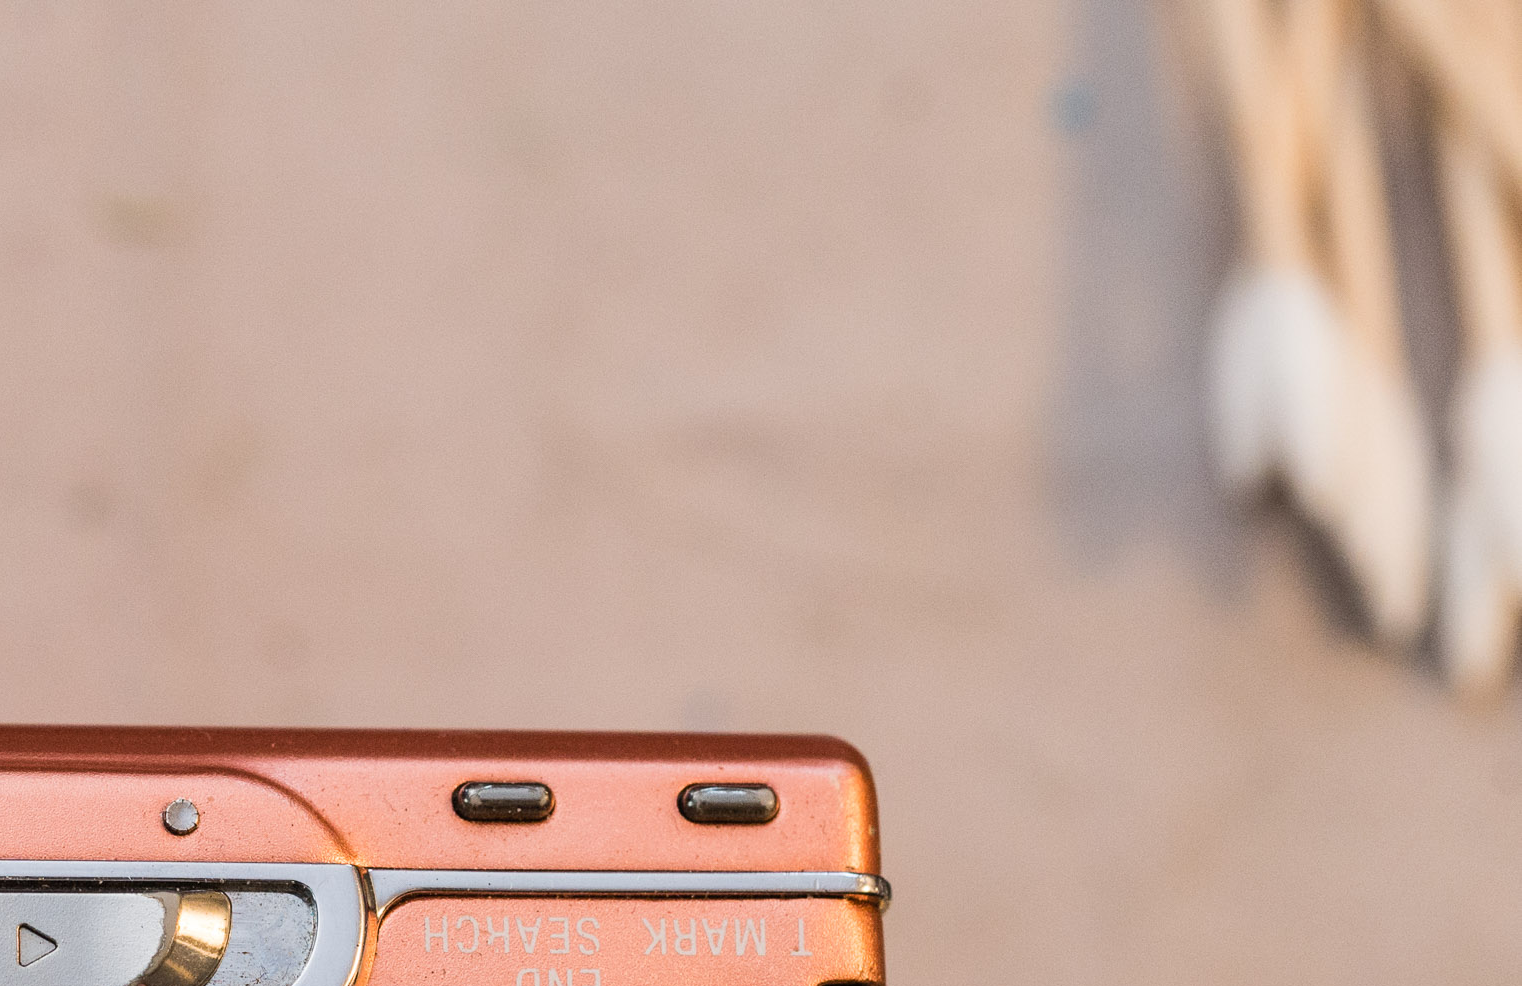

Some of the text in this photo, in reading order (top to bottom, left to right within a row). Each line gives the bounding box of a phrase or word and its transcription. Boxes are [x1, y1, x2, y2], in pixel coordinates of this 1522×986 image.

[423, 915, 602, 956] SEARCH
[641, 916, 814, 957] T MARK
